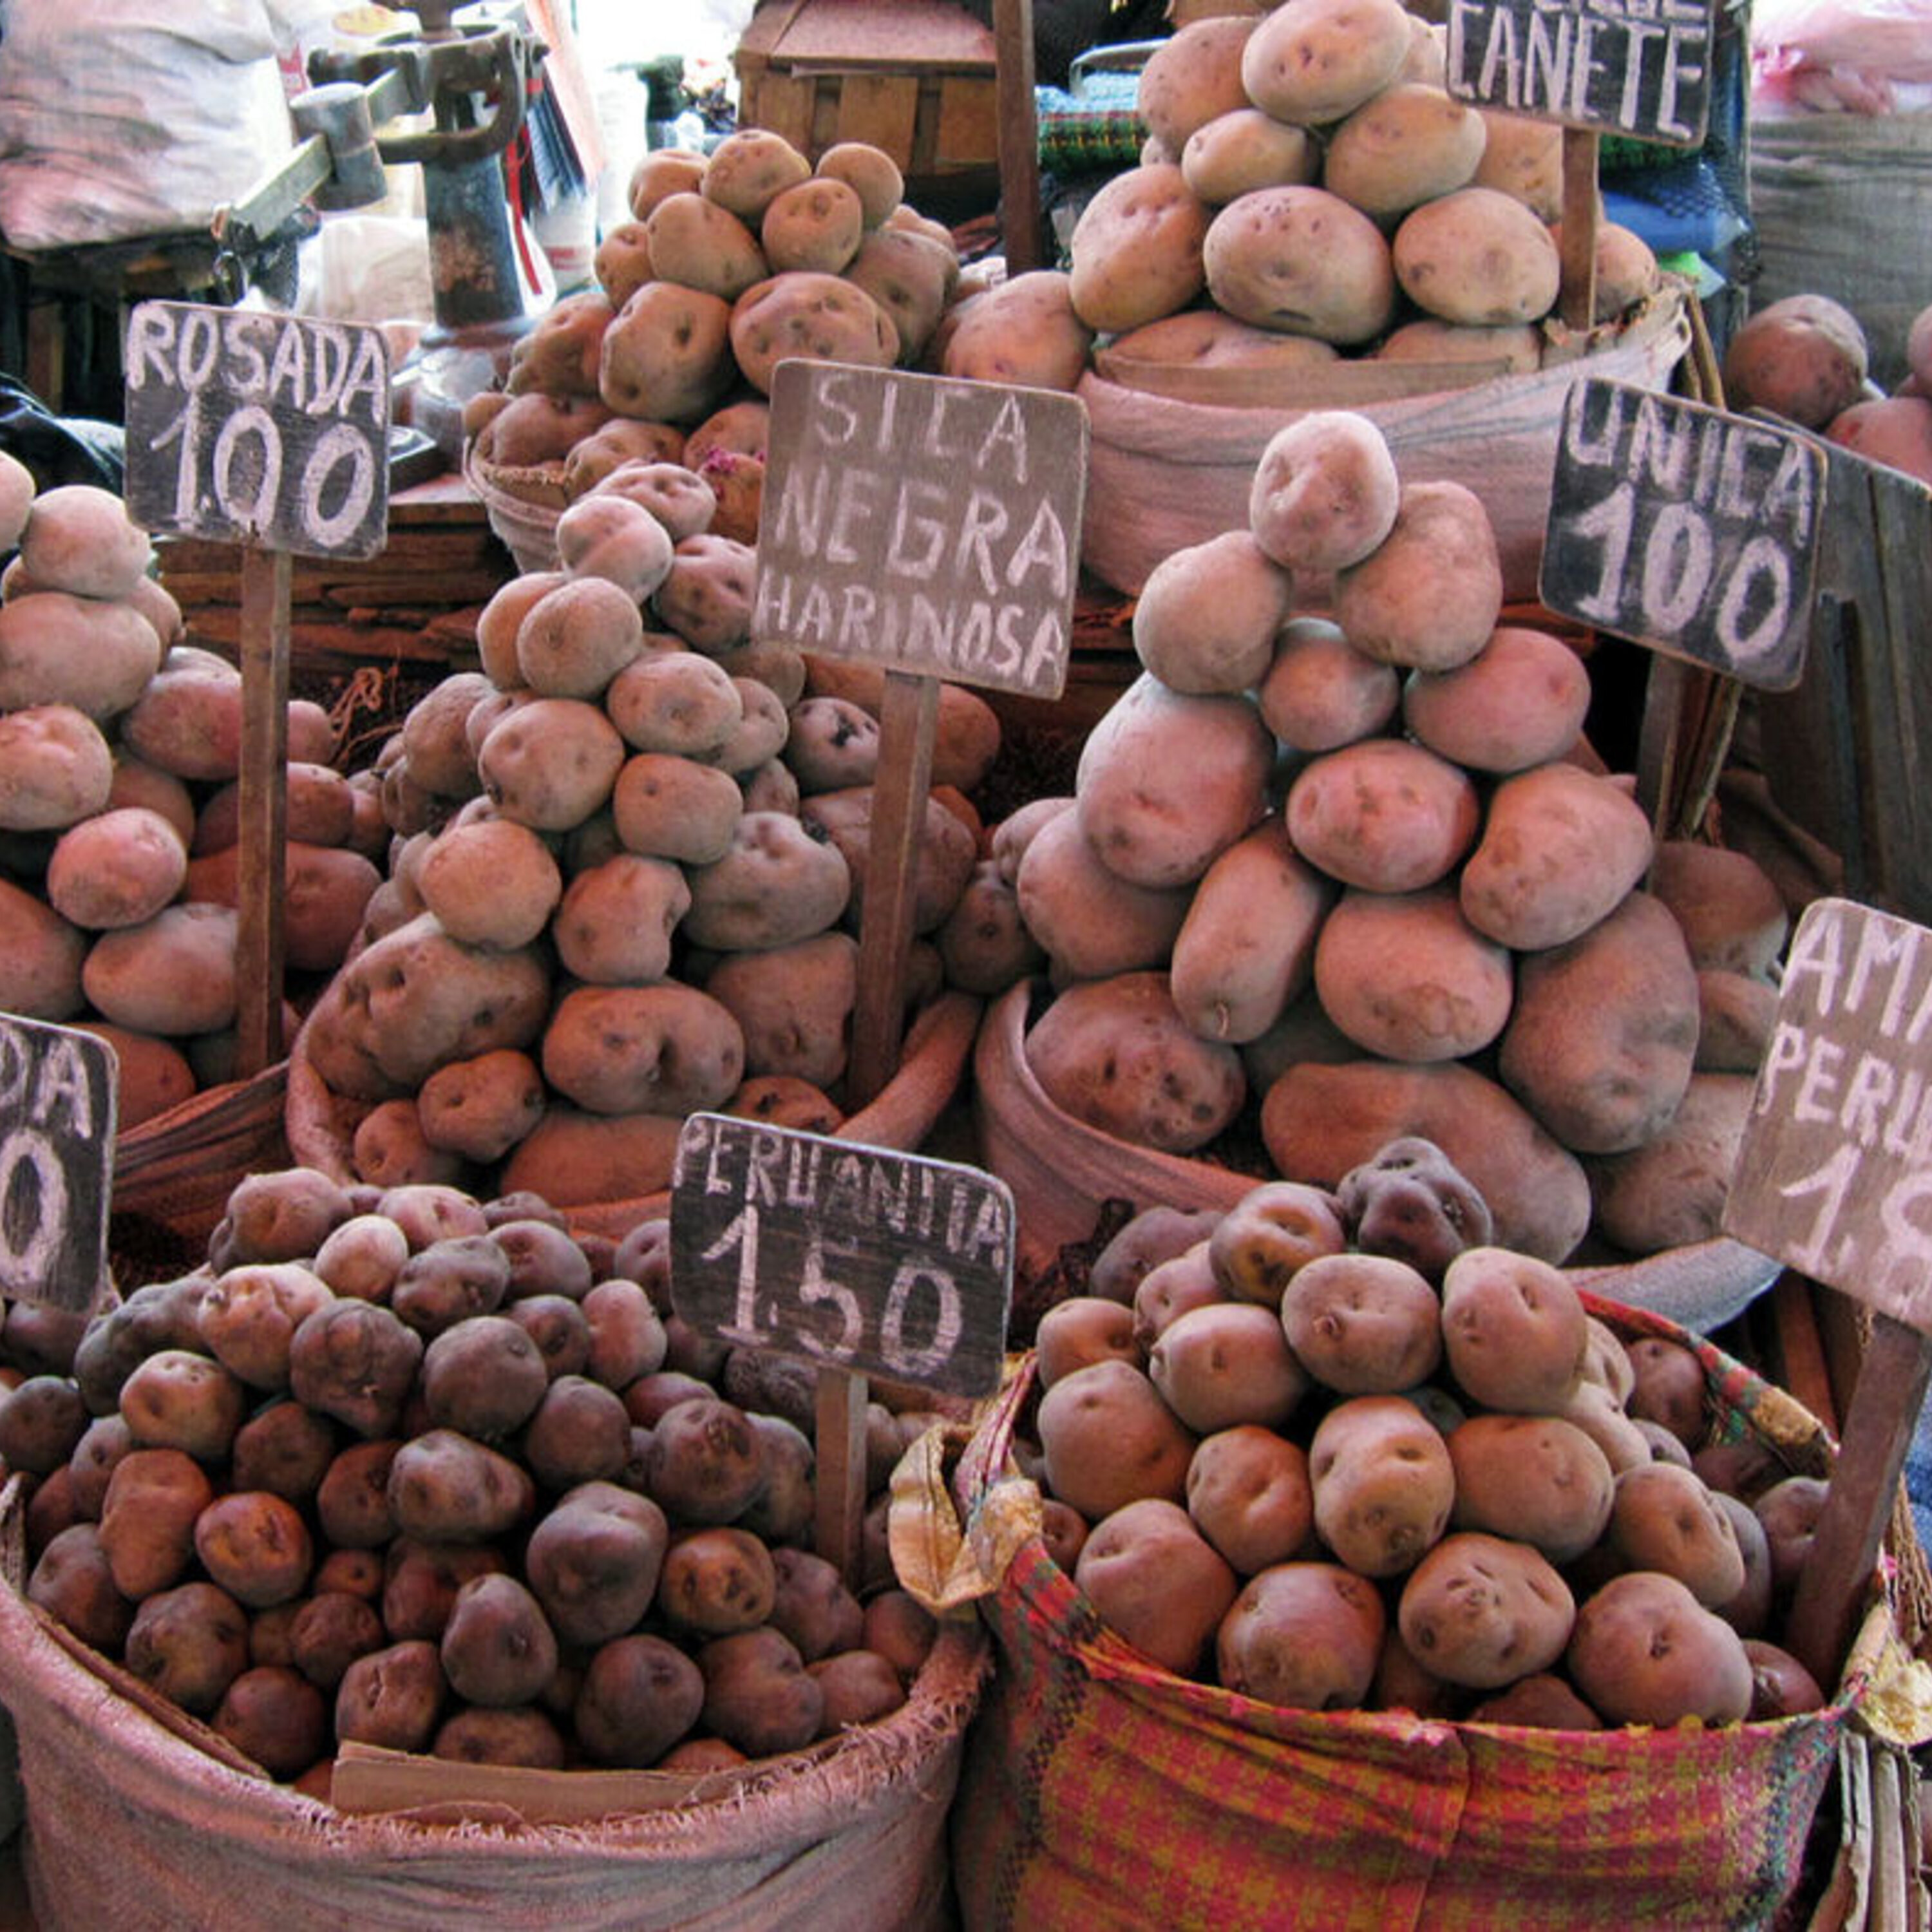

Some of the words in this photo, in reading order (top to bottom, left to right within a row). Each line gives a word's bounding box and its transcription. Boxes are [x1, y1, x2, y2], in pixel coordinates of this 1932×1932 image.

[128, 301, 386, 431] ROSADA
[149, 389, 375, 549] 1.00
[774, 460, 1069, 599] NEGRA
[1567, 377, 1813, 549] UNICA
[751, 565, 1064, 688] HARINOSA
[701, 1204, 963, 1377] 1.50
